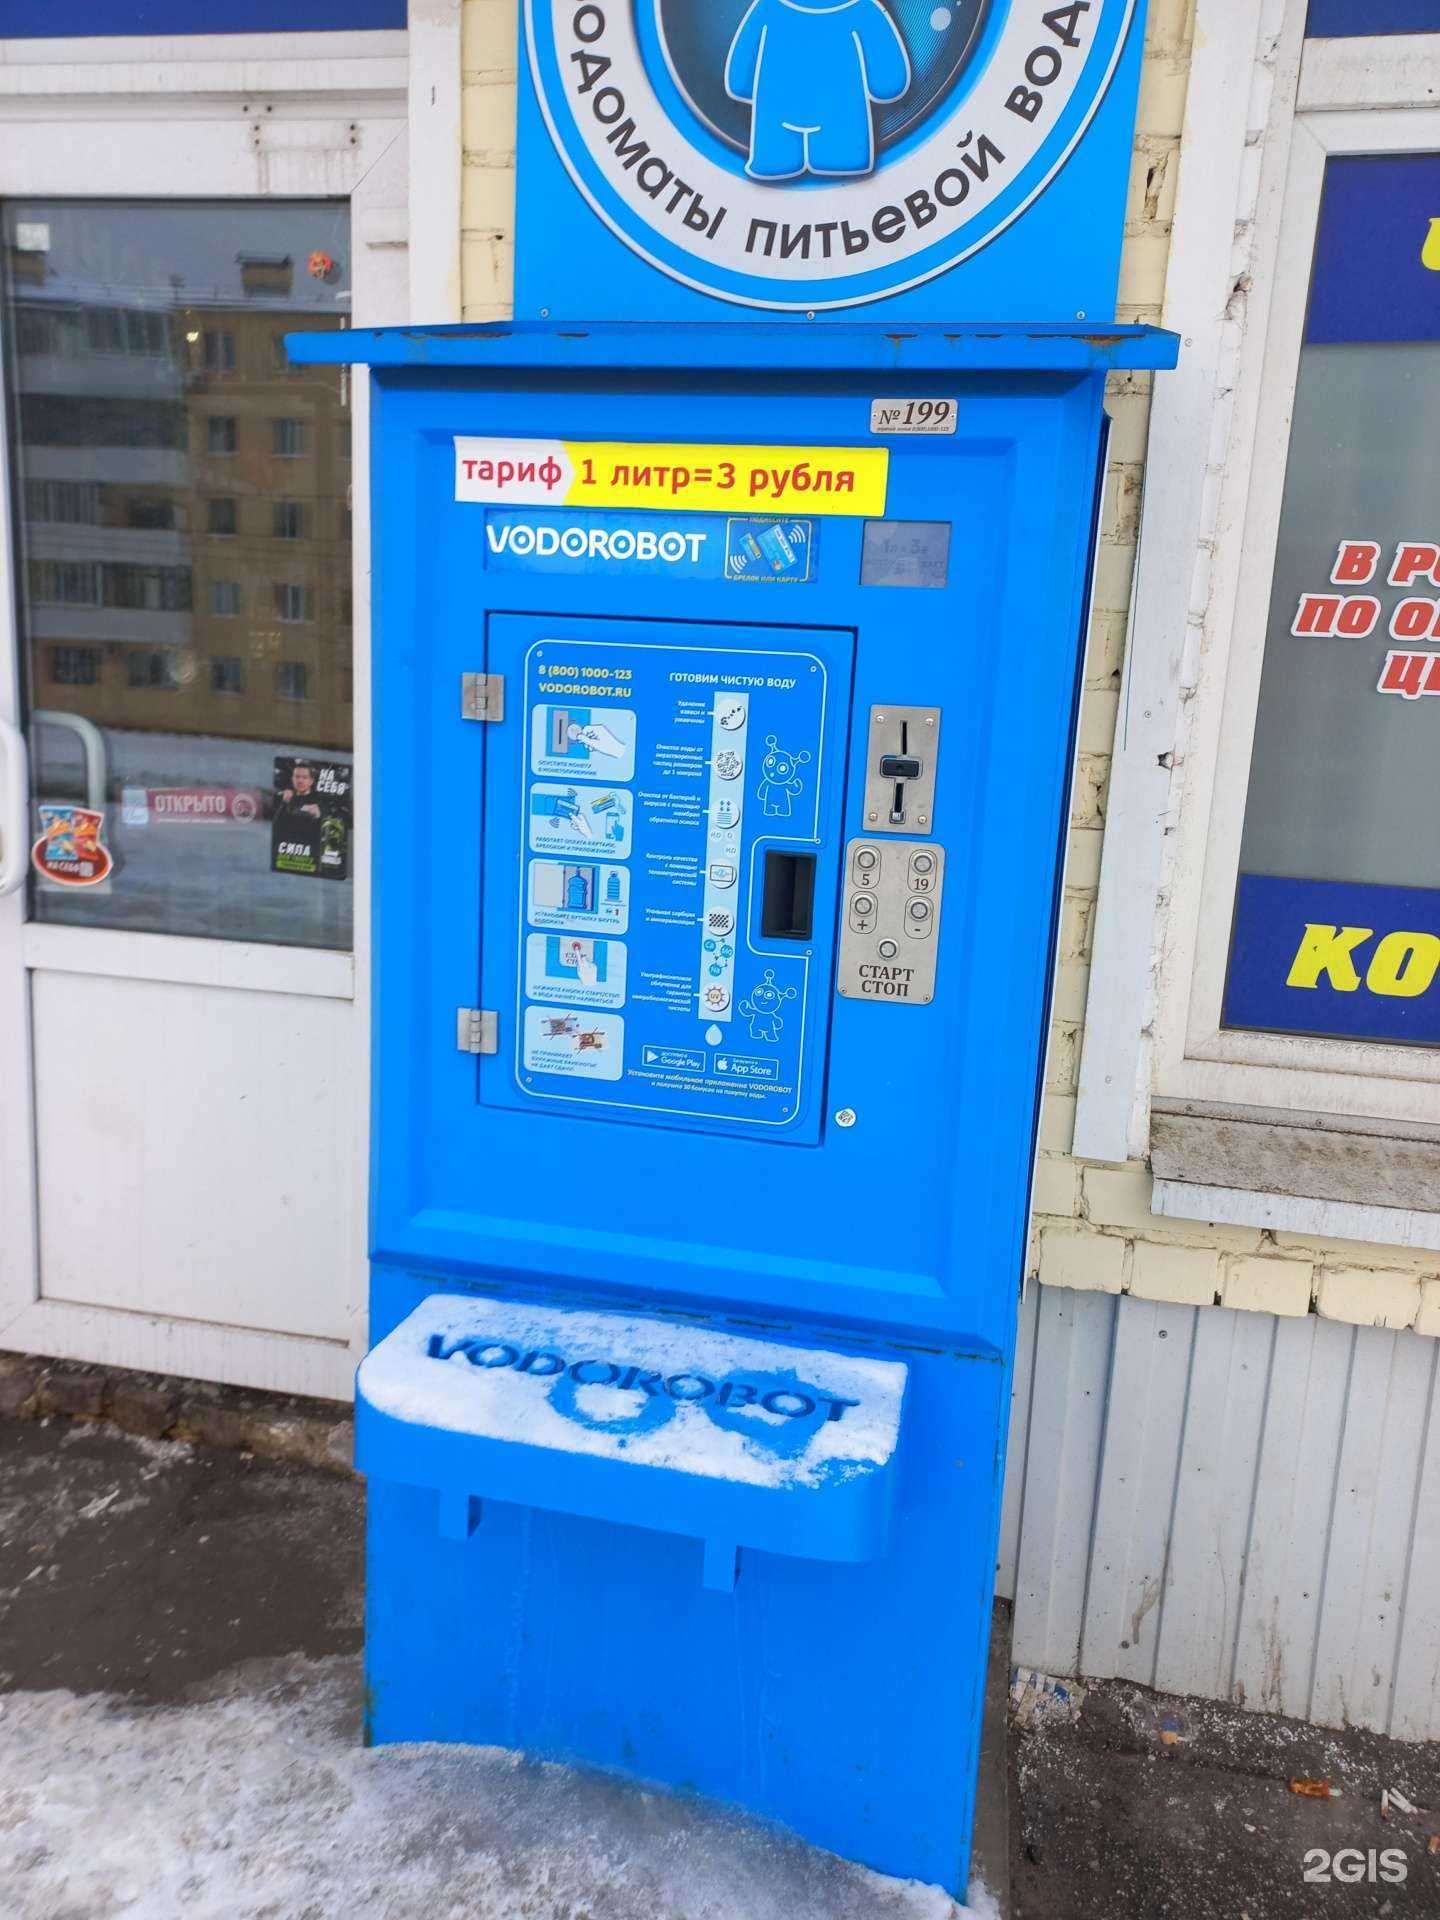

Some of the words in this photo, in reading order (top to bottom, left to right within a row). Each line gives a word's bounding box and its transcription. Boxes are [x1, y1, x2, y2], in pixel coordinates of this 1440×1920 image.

[571, 0, 728, 241] одоматы
[463, 456, 562, 490] тариф
[582, 459, 597, 484] 1
[749, 463, 855, 498] рубля
[487, 525, 707, 562] VODOROBOT
[1332, 541, 1380, 583] В
[1389, 543, 1440, 587] Р
[1292, 594, 1380, 637] ПО
[1390, 598, 1440, 640] О
[548, 665, 578, 677] (800)
[581, 667, 632, 680] 1000-123
[669, 672, 719, 684] ГОТОВИМ
[721, 675, 764, 687] ЧИСТУЮ
[767, 677, 796, 689] ВОДУ
[538, 682, 631, 697] VODOROBOT.RU
[319, 768, 336, 781] НА
[316, 780, 347, 796] СЕБЯ
[155, 794, 227, 813] ОТКРЫТО
[278, 841, 311, 857] СИЛА
[862, 873, 870, 886] 5
[914, 878, 929, 891] 19
[858, 964, 915, 982] СТАРТ
[861, 980, 909, 997] СТОП
[661, 1057, 686, 1067] Google
[686, 1059, 701, 1069] Play
[731, 1063, 749, 1074] App
[750, 1065, 772, 1076] Store
[426, 1333, 861, 1422] VODOROBOT
